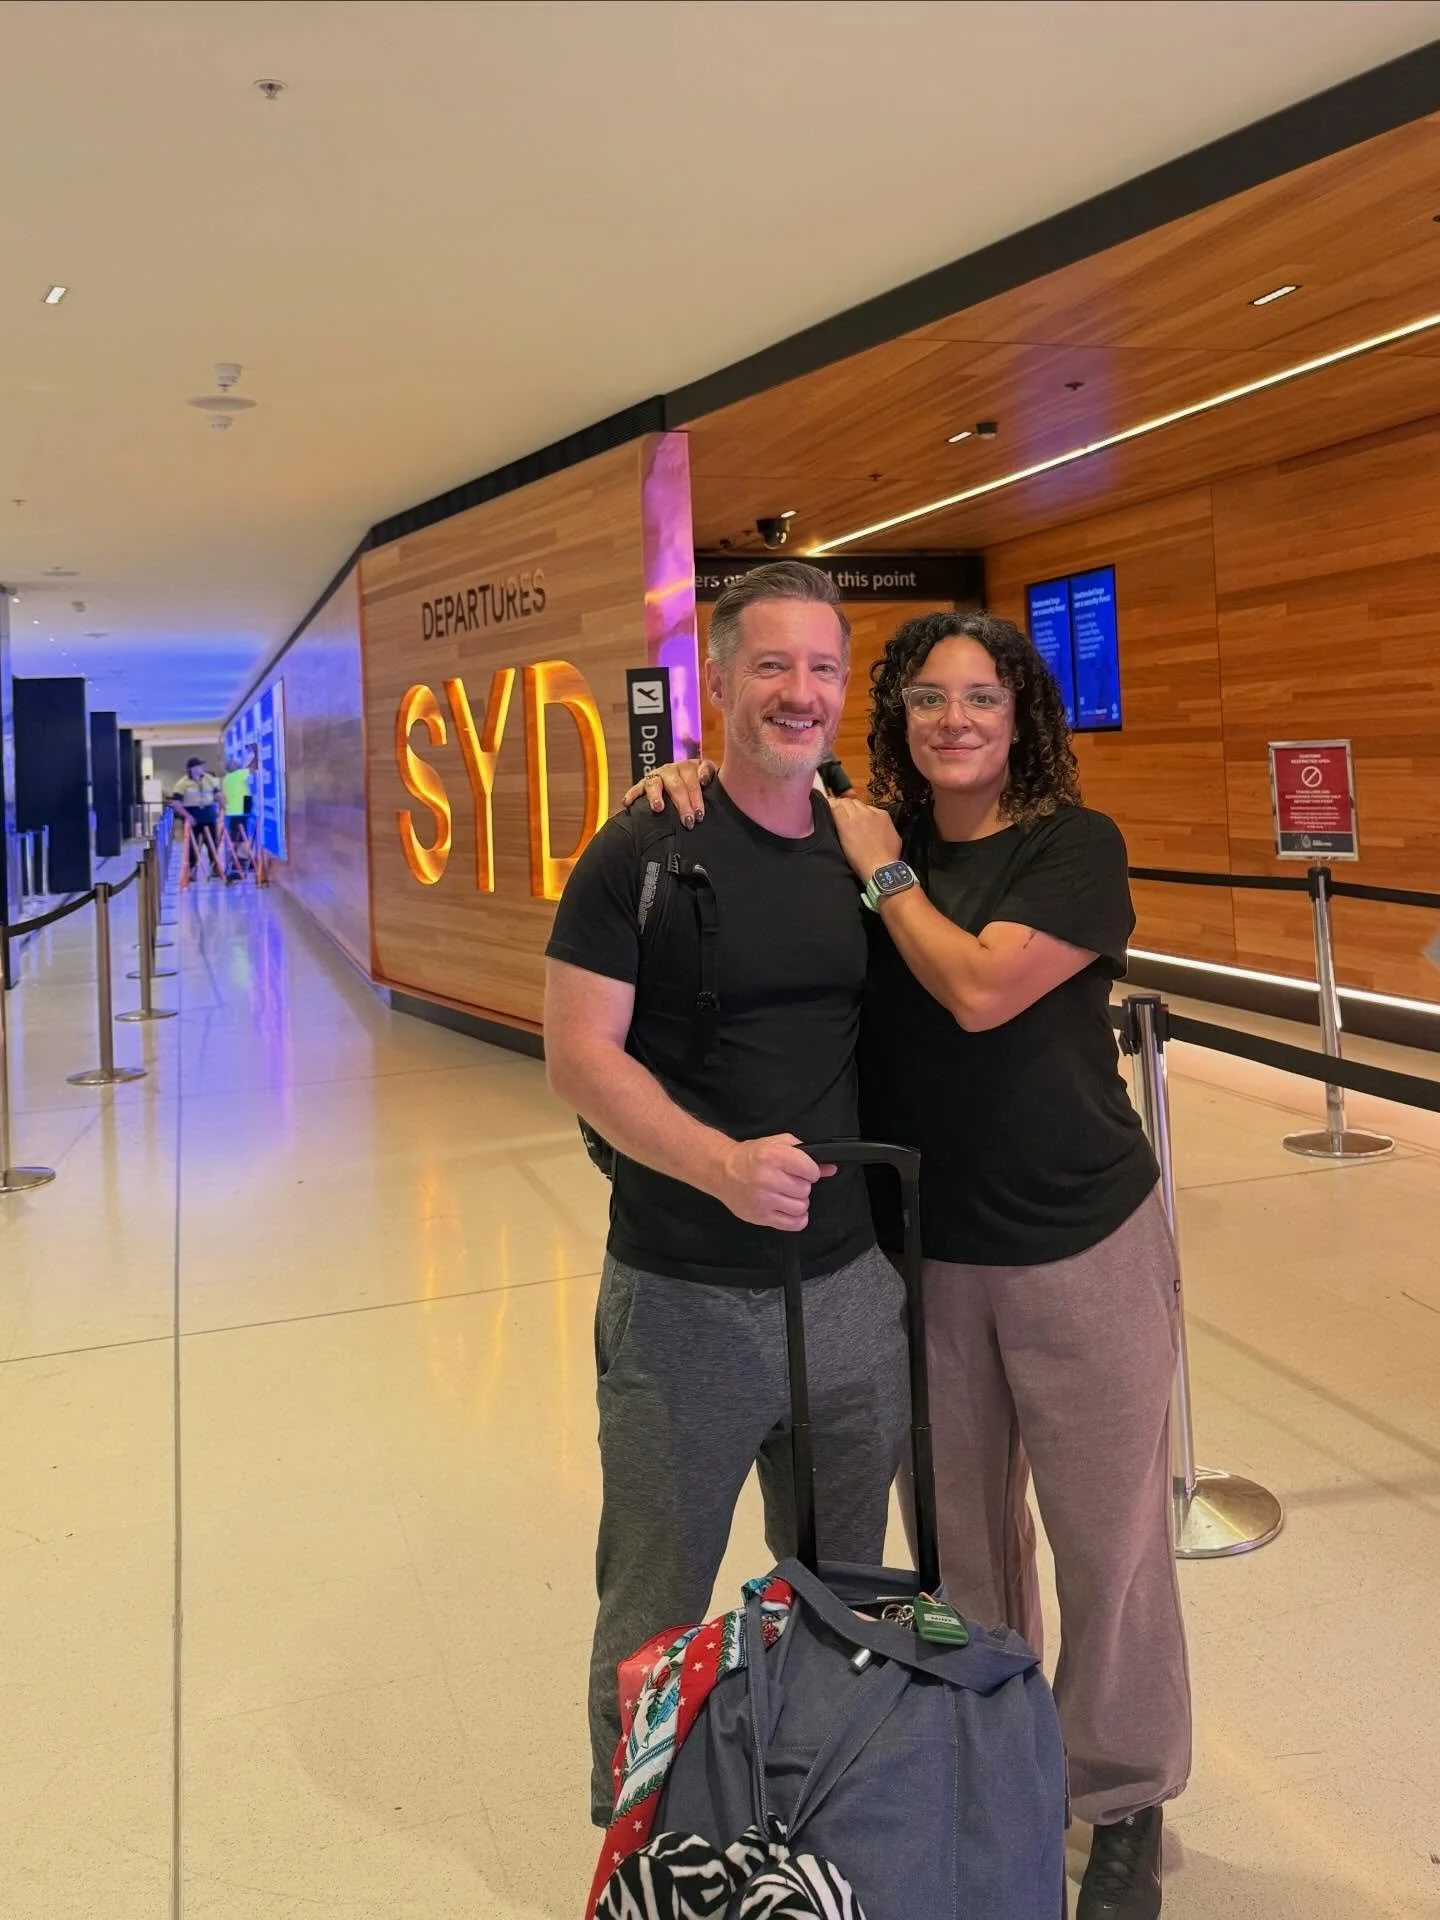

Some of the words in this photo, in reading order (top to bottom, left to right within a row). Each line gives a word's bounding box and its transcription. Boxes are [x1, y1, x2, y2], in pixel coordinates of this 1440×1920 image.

[422, 567, 546, 642] DEPARTURES
[837, 571, 869, 588] this
[872, 571, 917, 591] point
[395, 660, 609, 901] SYD
